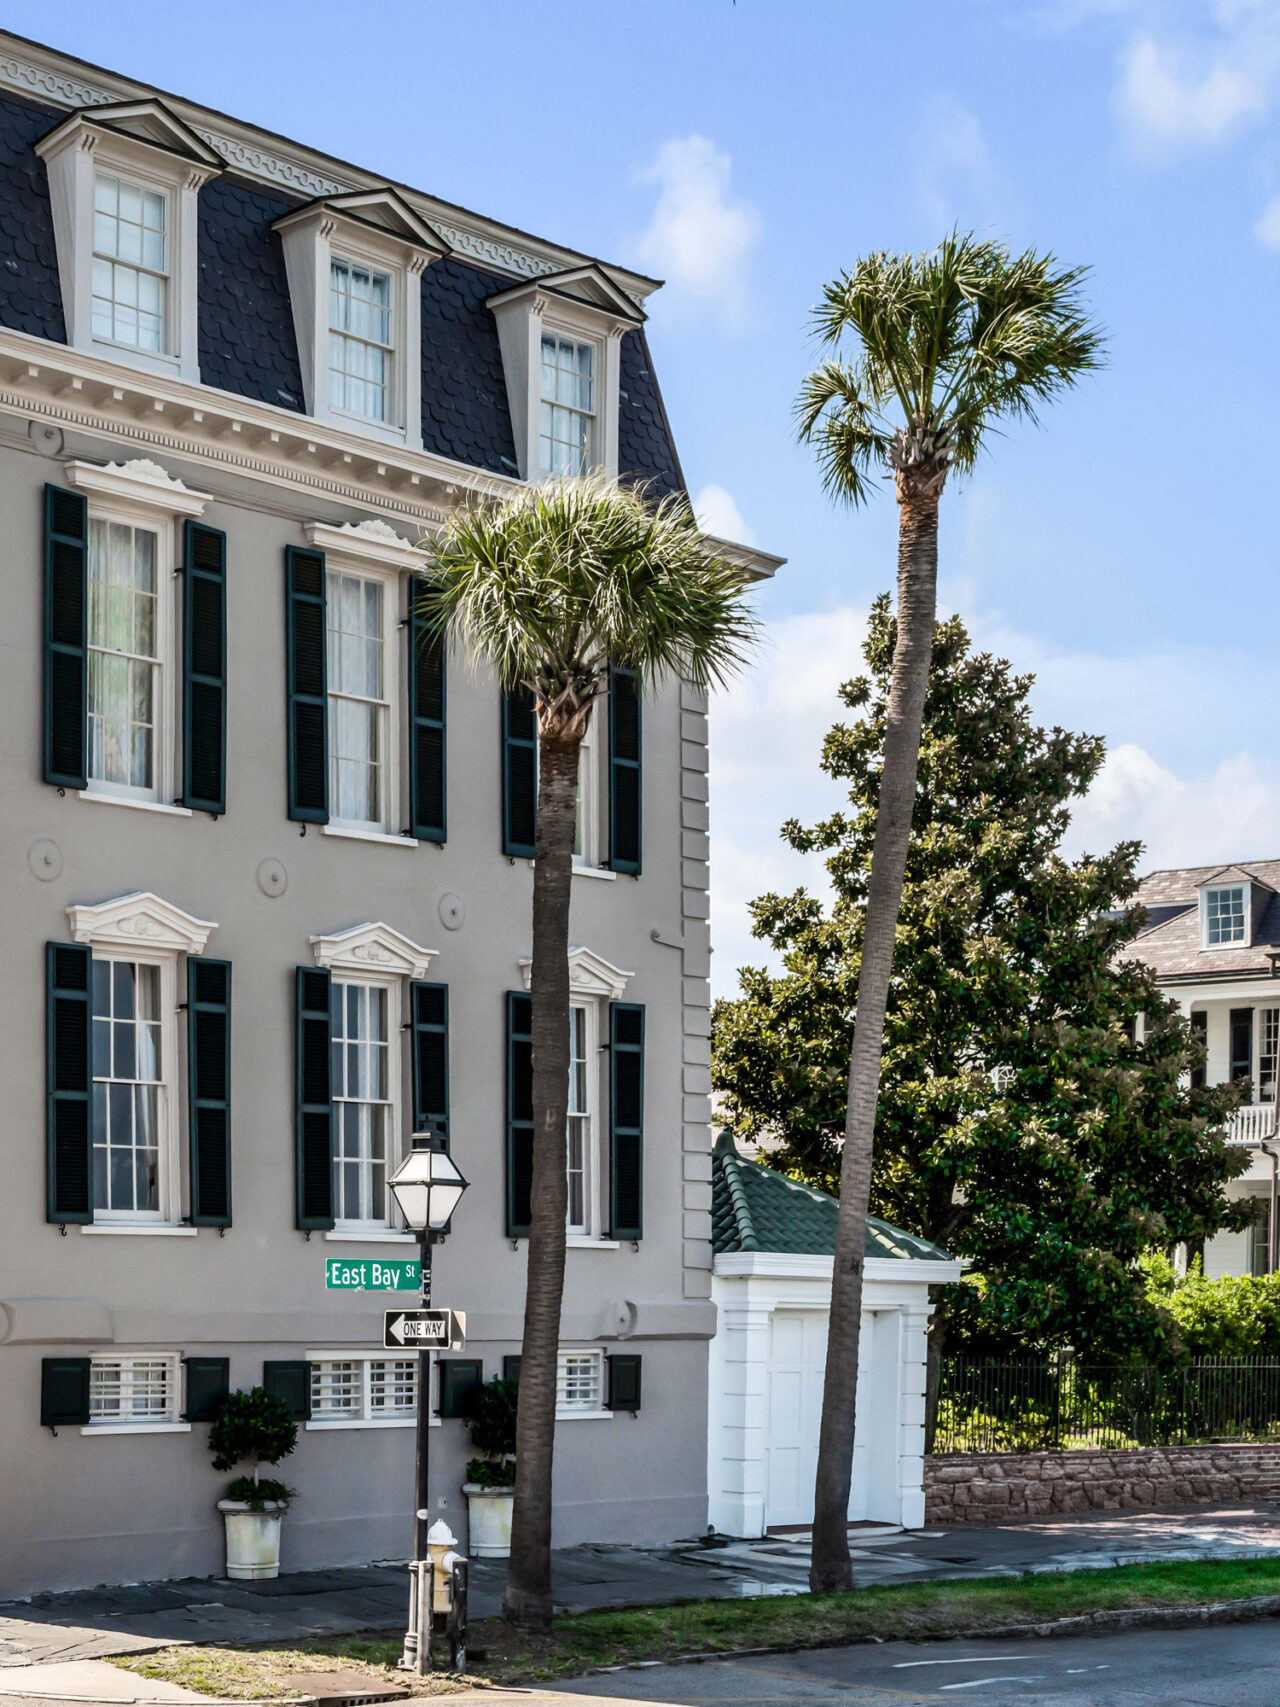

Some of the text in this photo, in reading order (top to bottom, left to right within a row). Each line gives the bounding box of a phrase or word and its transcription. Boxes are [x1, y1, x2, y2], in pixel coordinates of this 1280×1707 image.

[332, 1263, 415, 1289] East Bay St
[403, 1322, 442, 1336] ONE WAY
